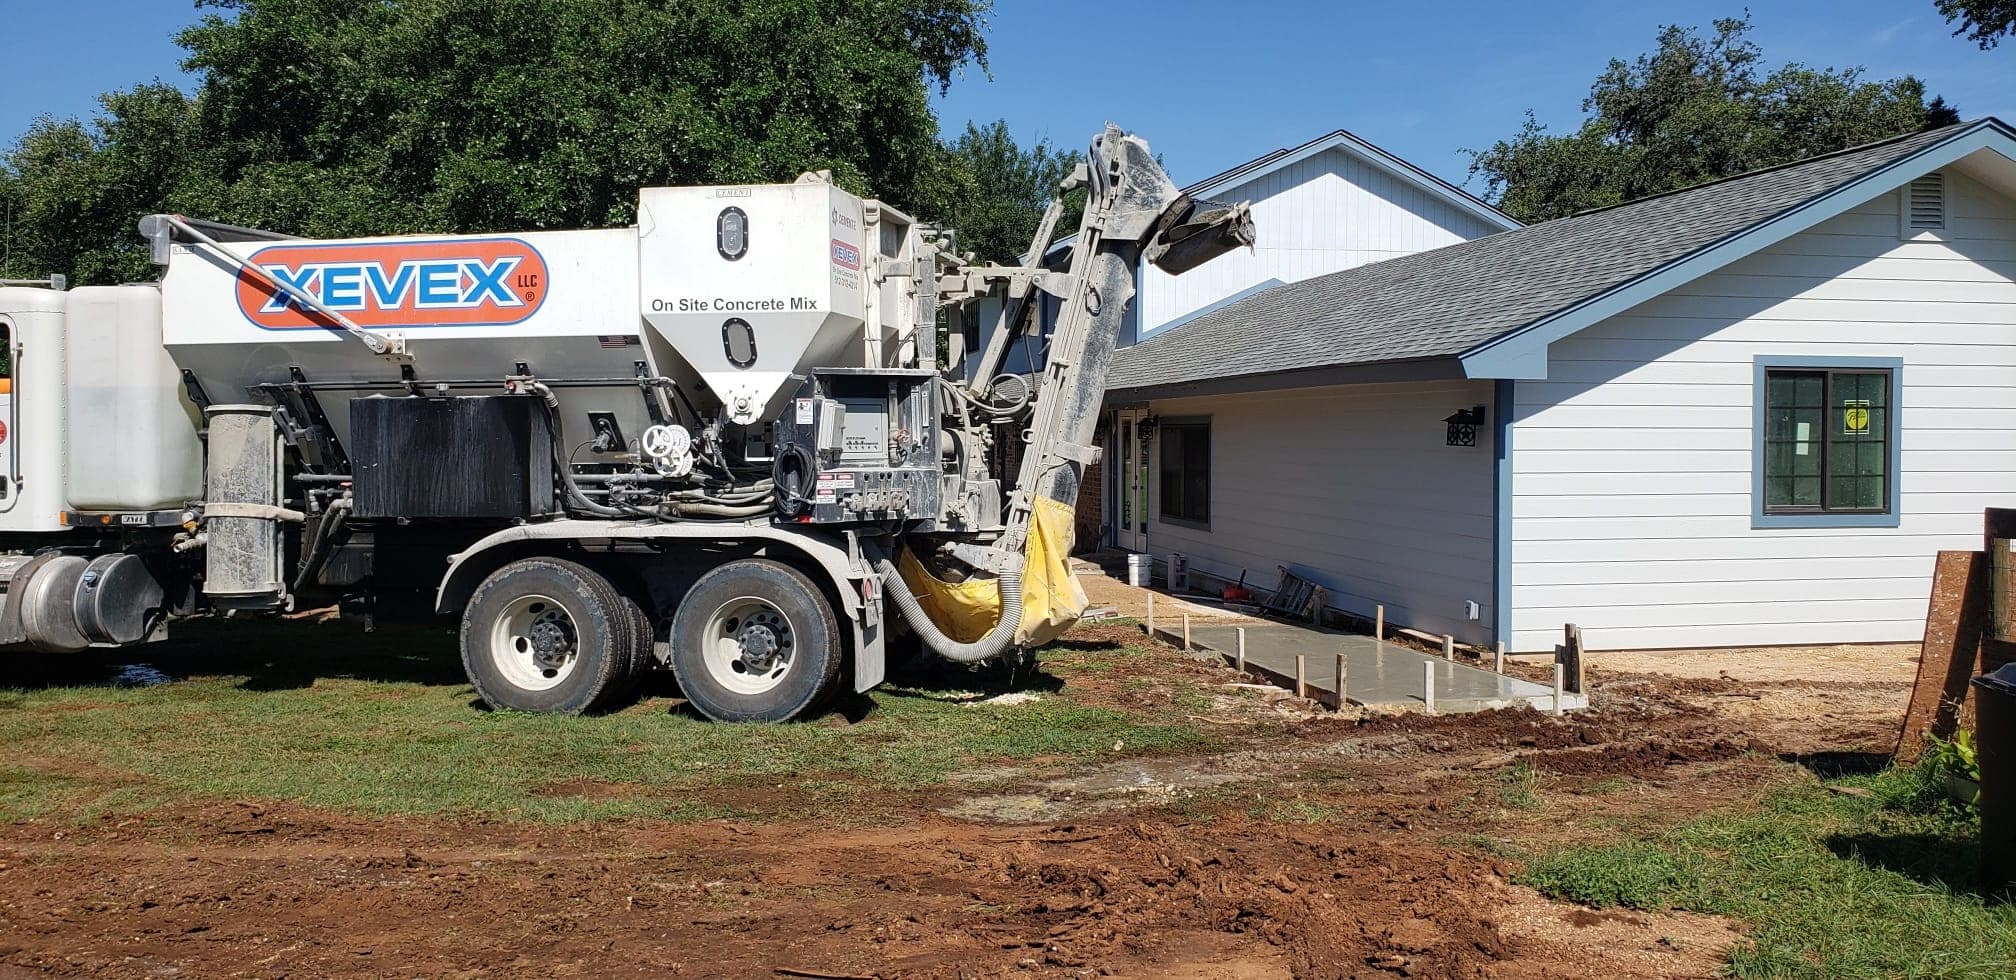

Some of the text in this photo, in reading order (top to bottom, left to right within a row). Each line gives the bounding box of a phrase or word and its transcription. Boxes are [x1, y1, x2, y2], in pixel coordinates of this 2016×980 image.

[258, 256, 537, 314] XEVEX LLC
[651, 297, 818, 312] On Site Concrete Mix
